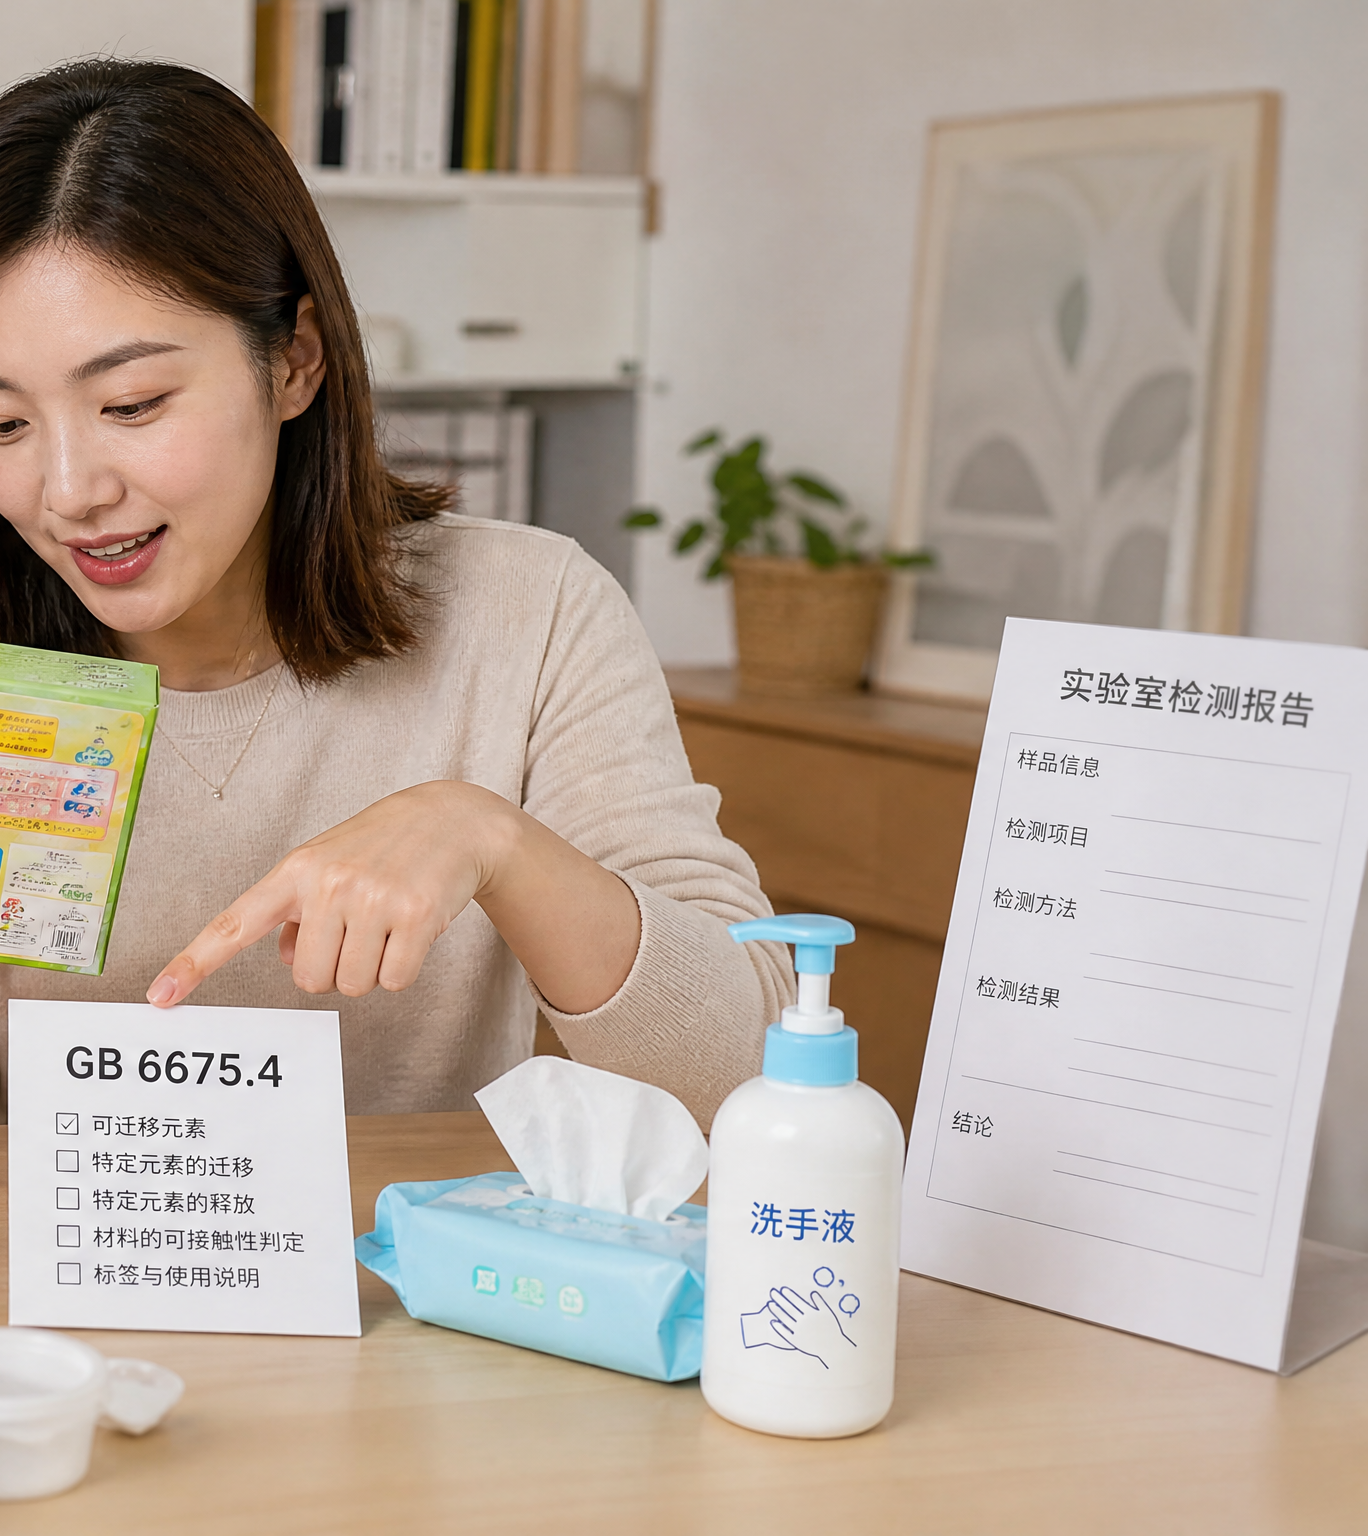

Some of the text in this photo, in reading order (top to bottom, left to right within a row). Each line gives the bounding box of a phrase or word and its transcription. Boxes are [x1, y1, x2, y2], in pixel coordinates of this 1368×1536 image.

[1061, 668, 1313, 728] 实验室检测报告
[1018, 749, 1099, 777] 样品信息
[1006, 818, 1087, 847] 检测项目
[993, 887, 1076, 919] 检测方法
[977, 976, 1059, 1008] 检测结果
[67, 1046, 282, 1087] GB 6675.4
[92, 1116, 205, 1138] 可迁移元素
[952, 1111, 993, 1137] 结论
[93, 1152, 253, 1177] 特定元素的迁移
[93, 1189, 254, 1214] 特定元素的释放
[751, 1202, 855, 1243] 洗手液
[94, 1227, 304, 1252] 材料的可接触性判定
[94, 1264, 259, 1288] 标签与使用说明
